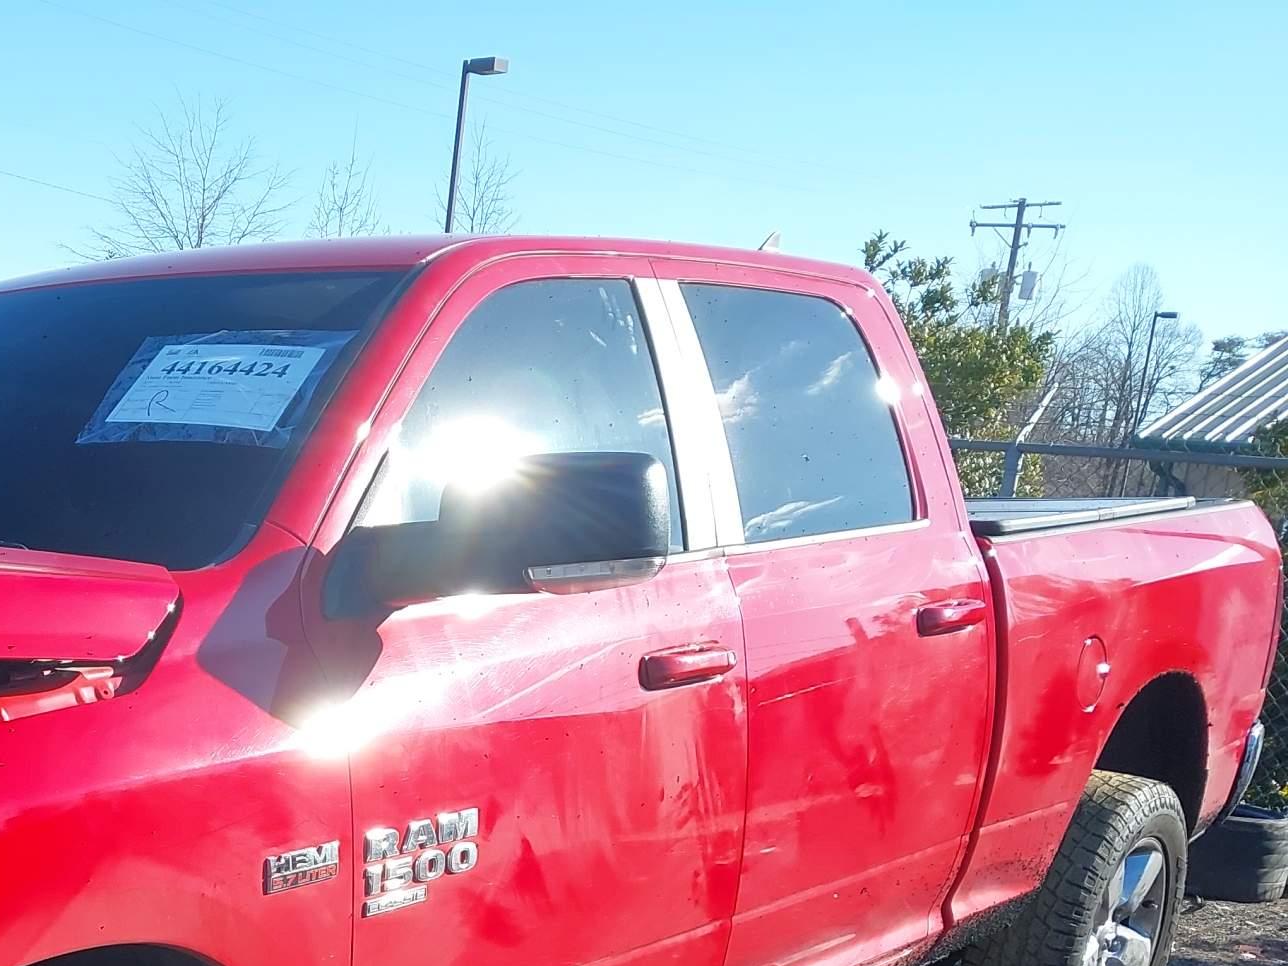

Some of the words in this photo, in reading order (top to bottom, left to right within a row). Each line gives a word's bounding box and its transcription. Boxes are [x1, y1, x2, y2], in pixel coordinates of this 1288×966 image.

[161, 360, 291, 378] 44164424
[147, 389, 177, 417] R
[364, 807, 480, 862] RAM
[270, 841, 340, 876] HEMI
[364, 841, 479, 898] 1500
[297, 864, 337, 885] LITER
